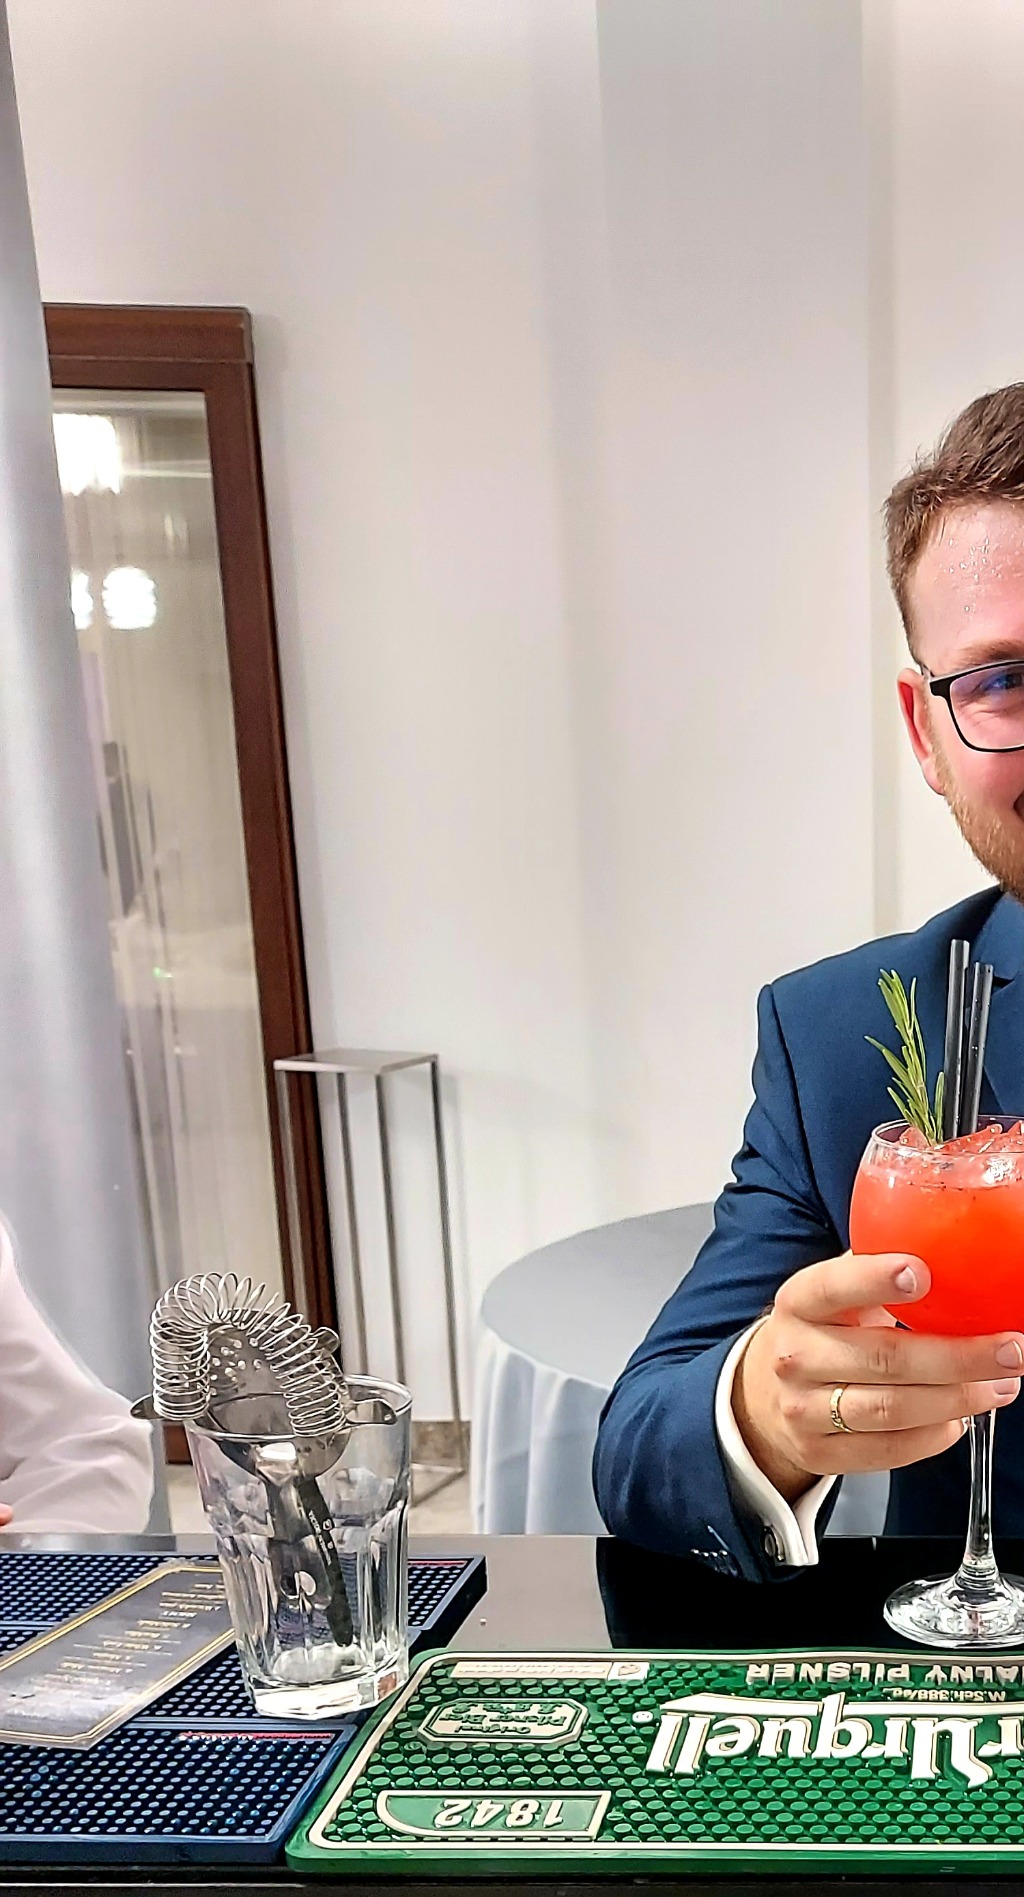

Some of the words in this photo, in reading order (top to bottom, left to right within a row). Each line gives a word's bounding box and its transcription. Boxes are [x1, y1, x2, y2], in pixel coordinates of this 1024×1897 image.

[745, 1661, 910, 1685] PILSNER
[645, 1691, 994, 1789] Urquell
[432, 1799, 564, 1829] 1842
